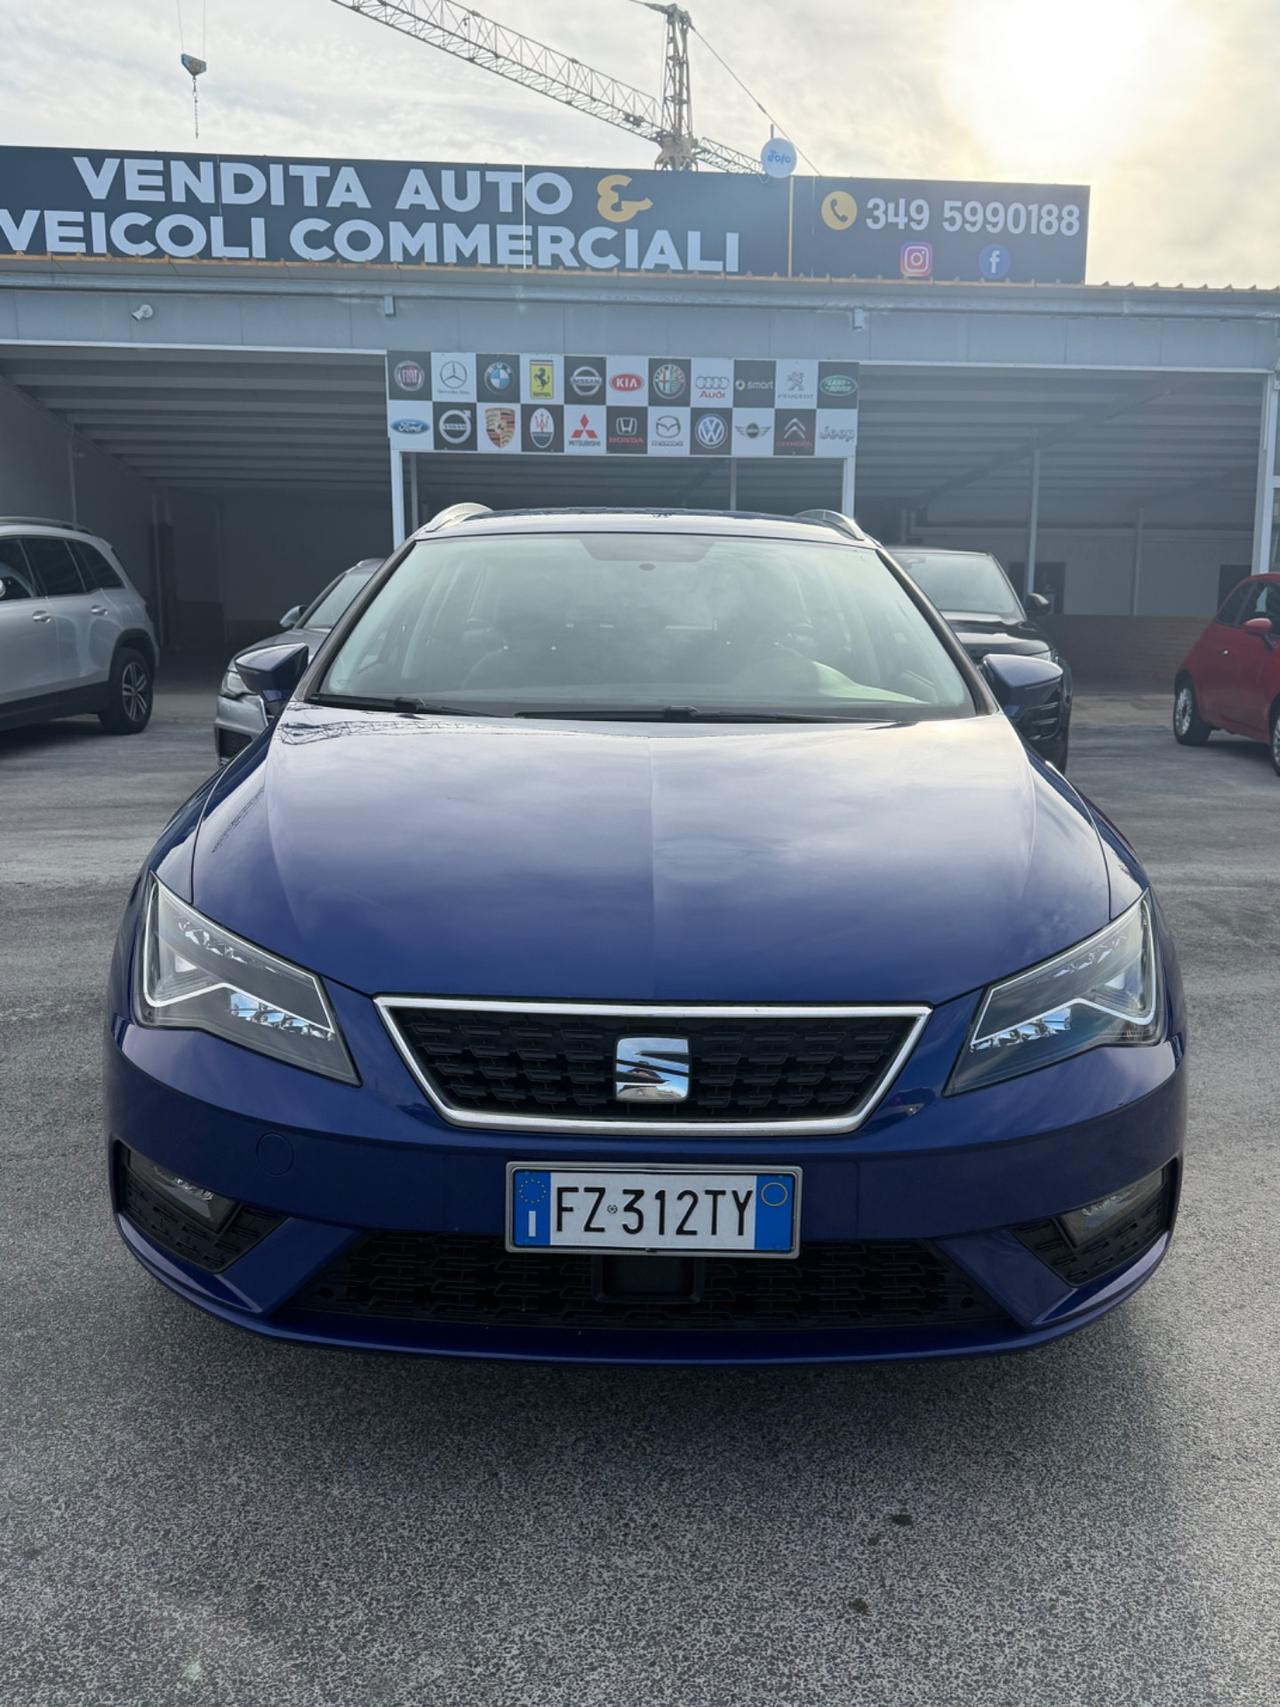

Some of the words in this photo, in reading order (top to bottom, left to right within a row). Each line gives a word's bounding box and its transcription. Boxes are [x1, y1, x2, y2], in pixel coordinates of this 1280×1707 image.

[72, 156, 372, 209] VENDITA
[395, 168, 573, 216] AUTO
[597, 174, 653, 223] &
[866, 197, 930, 231] 349
[942, 201, 1081, 237] 5990188
[0, 209, 267, 259] VEICOLI
[289, 217, 740, 273] COMMERCIALI
[615, 378, 638, 388] KIA
[747, 380, 774, 390] smart
[699, 390, 726, 400] Audi
[397, 421, 423, 433] Ford
